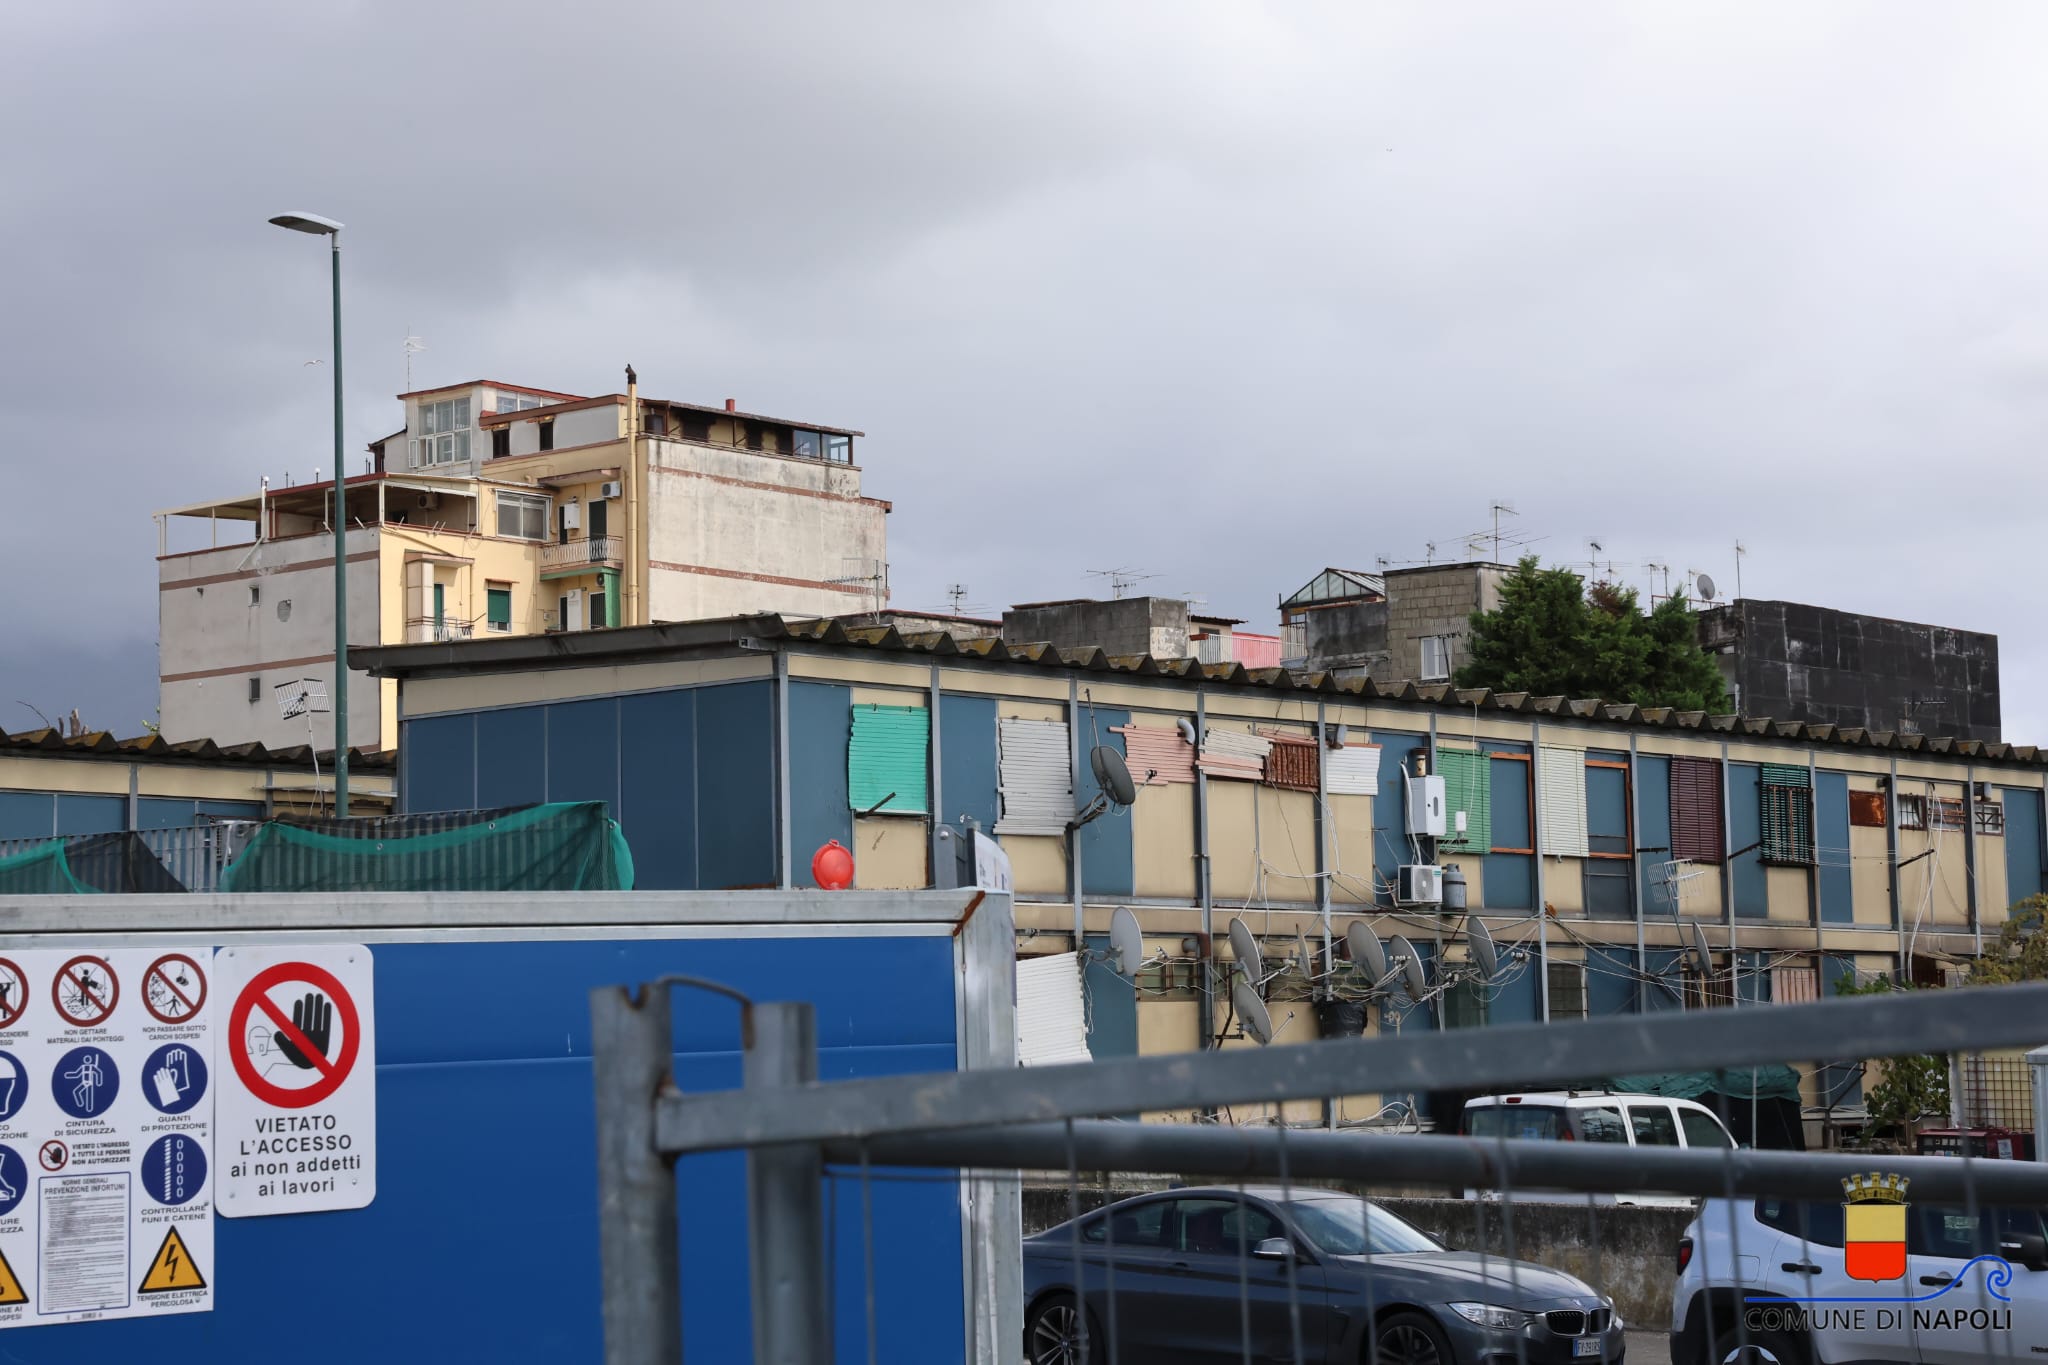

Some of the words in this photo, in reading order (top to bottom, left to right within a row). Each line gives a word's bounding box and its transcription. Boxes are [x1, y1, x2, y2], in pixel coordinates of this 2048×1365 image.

[152, 1123, 207, 1131] PROTEZIONE
[256, 1115, 336, 1133] VIETATO
[66, 1127, 116, 1135] SICUREZZA
[240, 1135, 351, 1155] L'ACCESSO
[231, 1163, 246, 1177] ai
[255, 1162, 288, 1175] non
[297, 1155, 360, 1173] addetti
[45, 1186, 89, 1194] PREVENZIONE
[91, 1184, 125, 1192] INFORTUNI
[259, 1182, 274, 1196] ai
[283, 1177, 334, 1194] lavori
[141, 1206, 206, 1215] CONTROLLARE
[172, 1213, 206, 1221] CATENE
[137, 1293, 170, 1301] TENSIONE
[172, 1290, 208, 1299] ELETTRICA
[151, 1299, 193, 1308] PERICOLOSA
